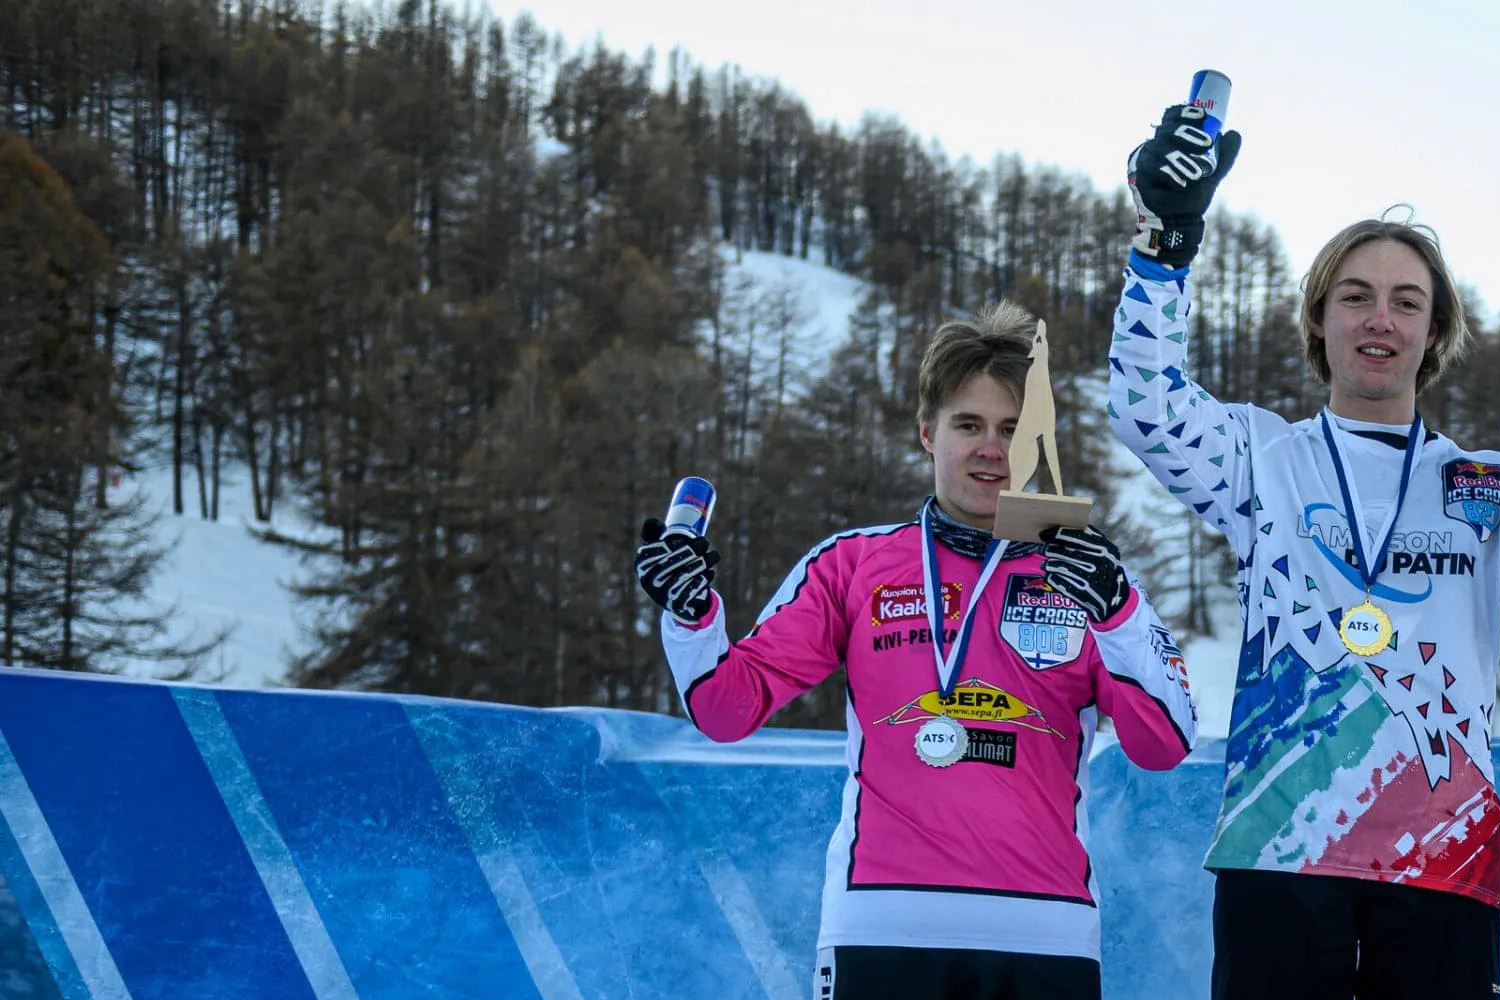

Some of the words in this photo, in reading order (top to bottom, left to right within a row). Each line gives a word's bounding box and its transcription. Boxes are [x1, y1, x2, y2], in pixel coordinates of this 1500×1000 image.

[1454, 475, 1484, 489] Red
[1447, 487, 1472, 504] ICE
[1391, 552, 1477, 578] PATIN
[1017, 592, 1051, 608] Red
[1006, 606, 1034, 622] ICE
[1034, 607, 1087, 627] CROSS
[1018, 624, 1069, 656] 806
[938, 692, 1011, 709] SEPA
